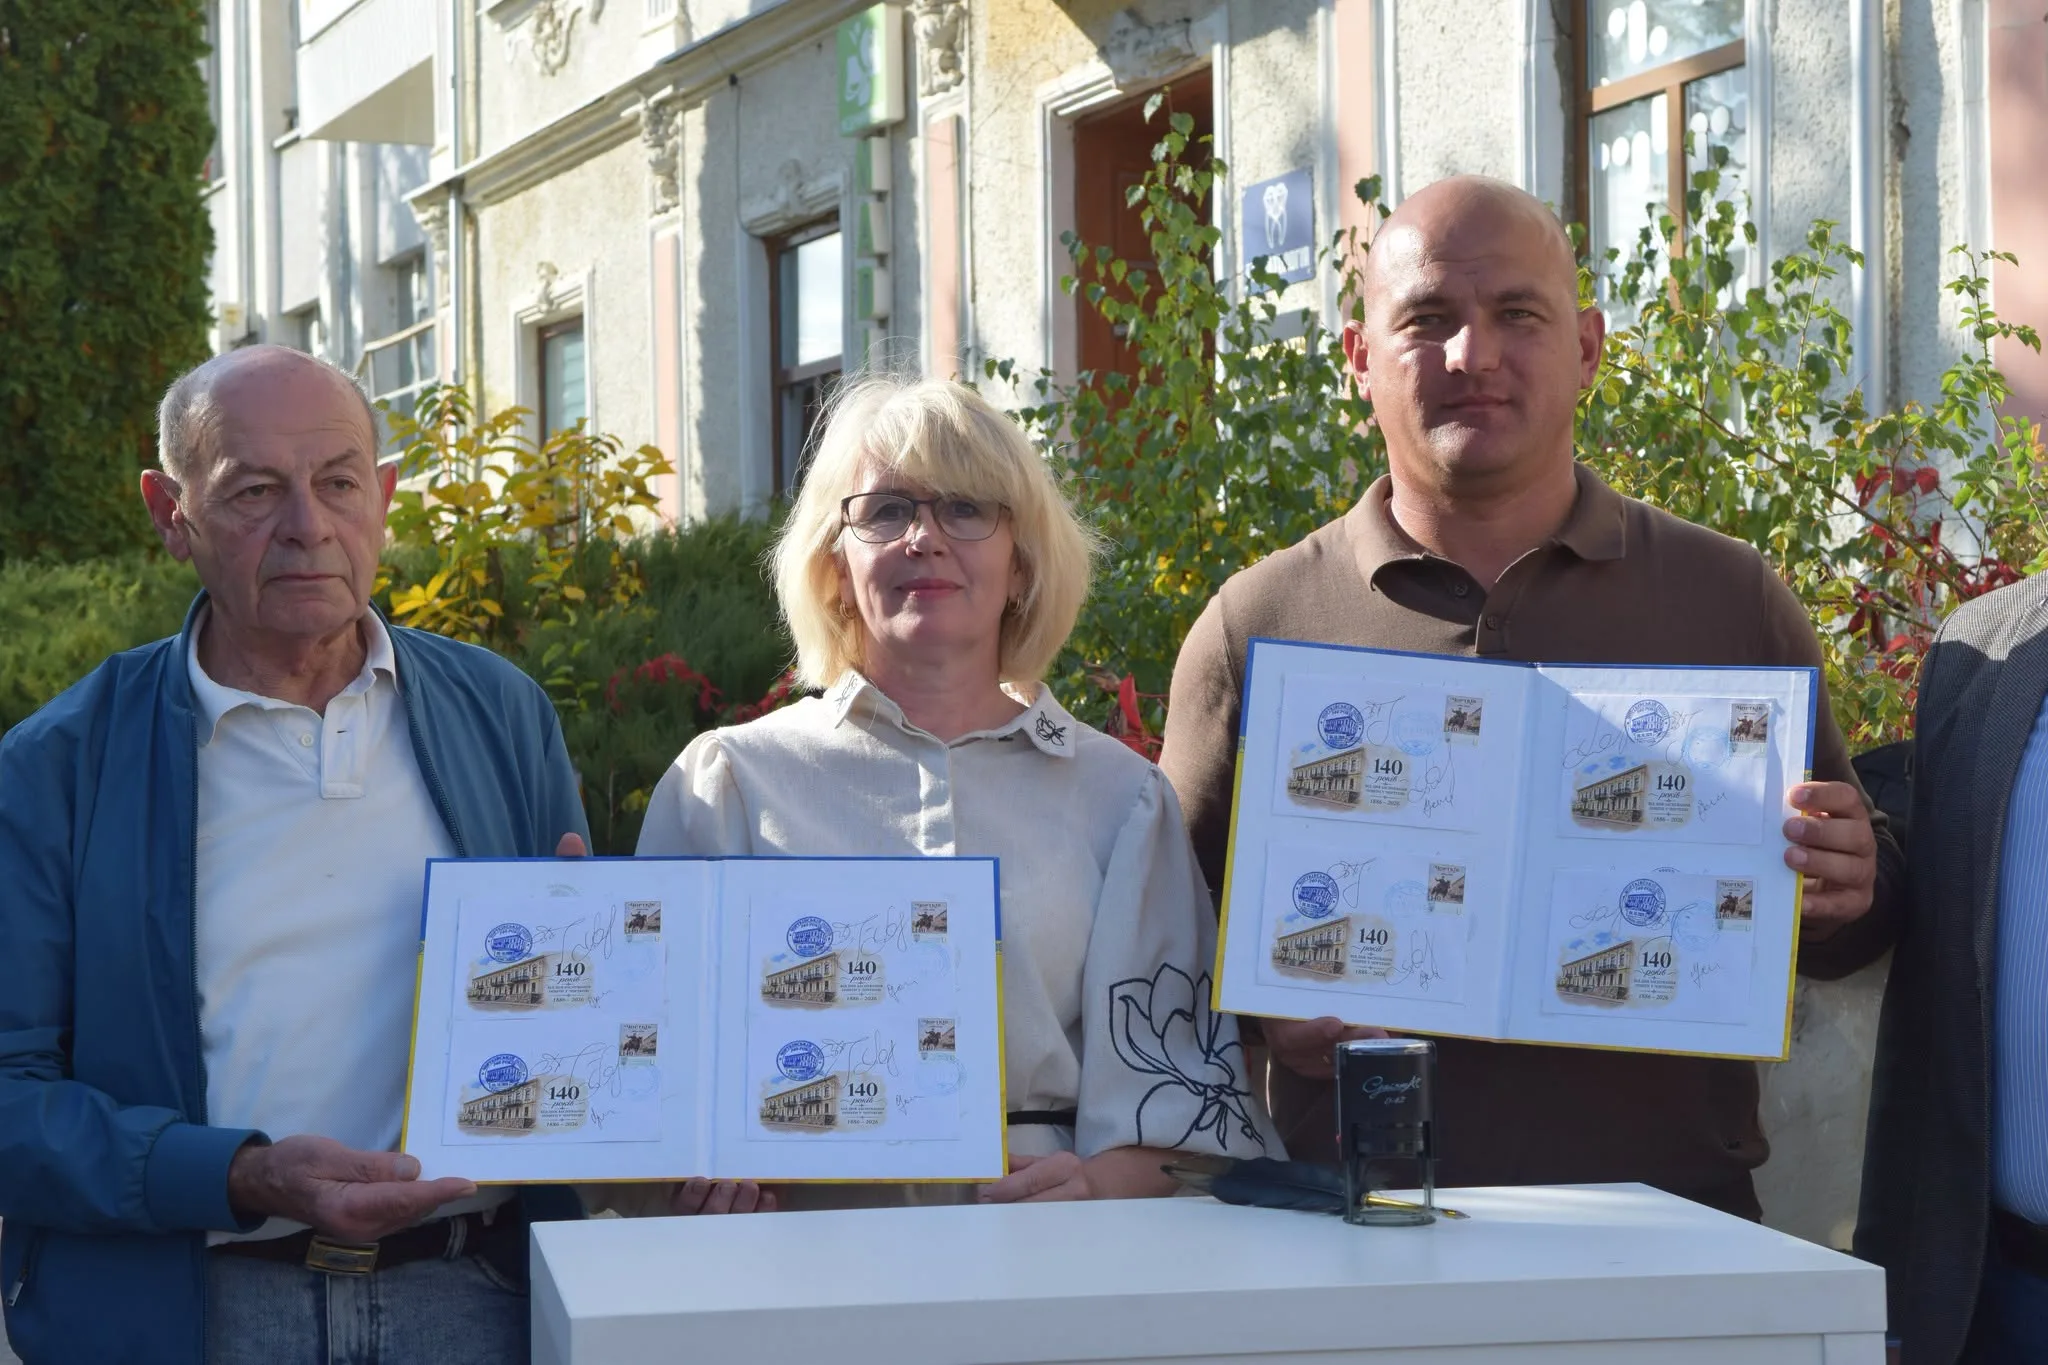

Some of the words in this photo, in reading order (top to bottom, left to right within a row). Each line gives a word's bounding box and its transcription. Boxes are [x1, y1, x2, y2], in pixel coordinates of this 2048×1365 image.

[1373, 758, 1403, 776] 140
[1375, 774, 1398, 785] років
[1656, 774, 1686, 791] 140
[1658, 791, 1681, 801] років
[1358, 927, 1389, 946] 140
[1360, 944, 1383, 955] років
[1642, 951, 1672, 968] 140
[555, 963, 586, 976] 140
[847, 961, 877, 974] 140
[1643, 968, 1667, 978] років
[557, 976, 581, 984] років
[850, 975, 872, 983] років
[549, 1086, 580, 1100] 140
[848, 1083, 878, 1096] 140
[551, 1100, 575, 1109] років
[850, 1097, 874, 1105] років
